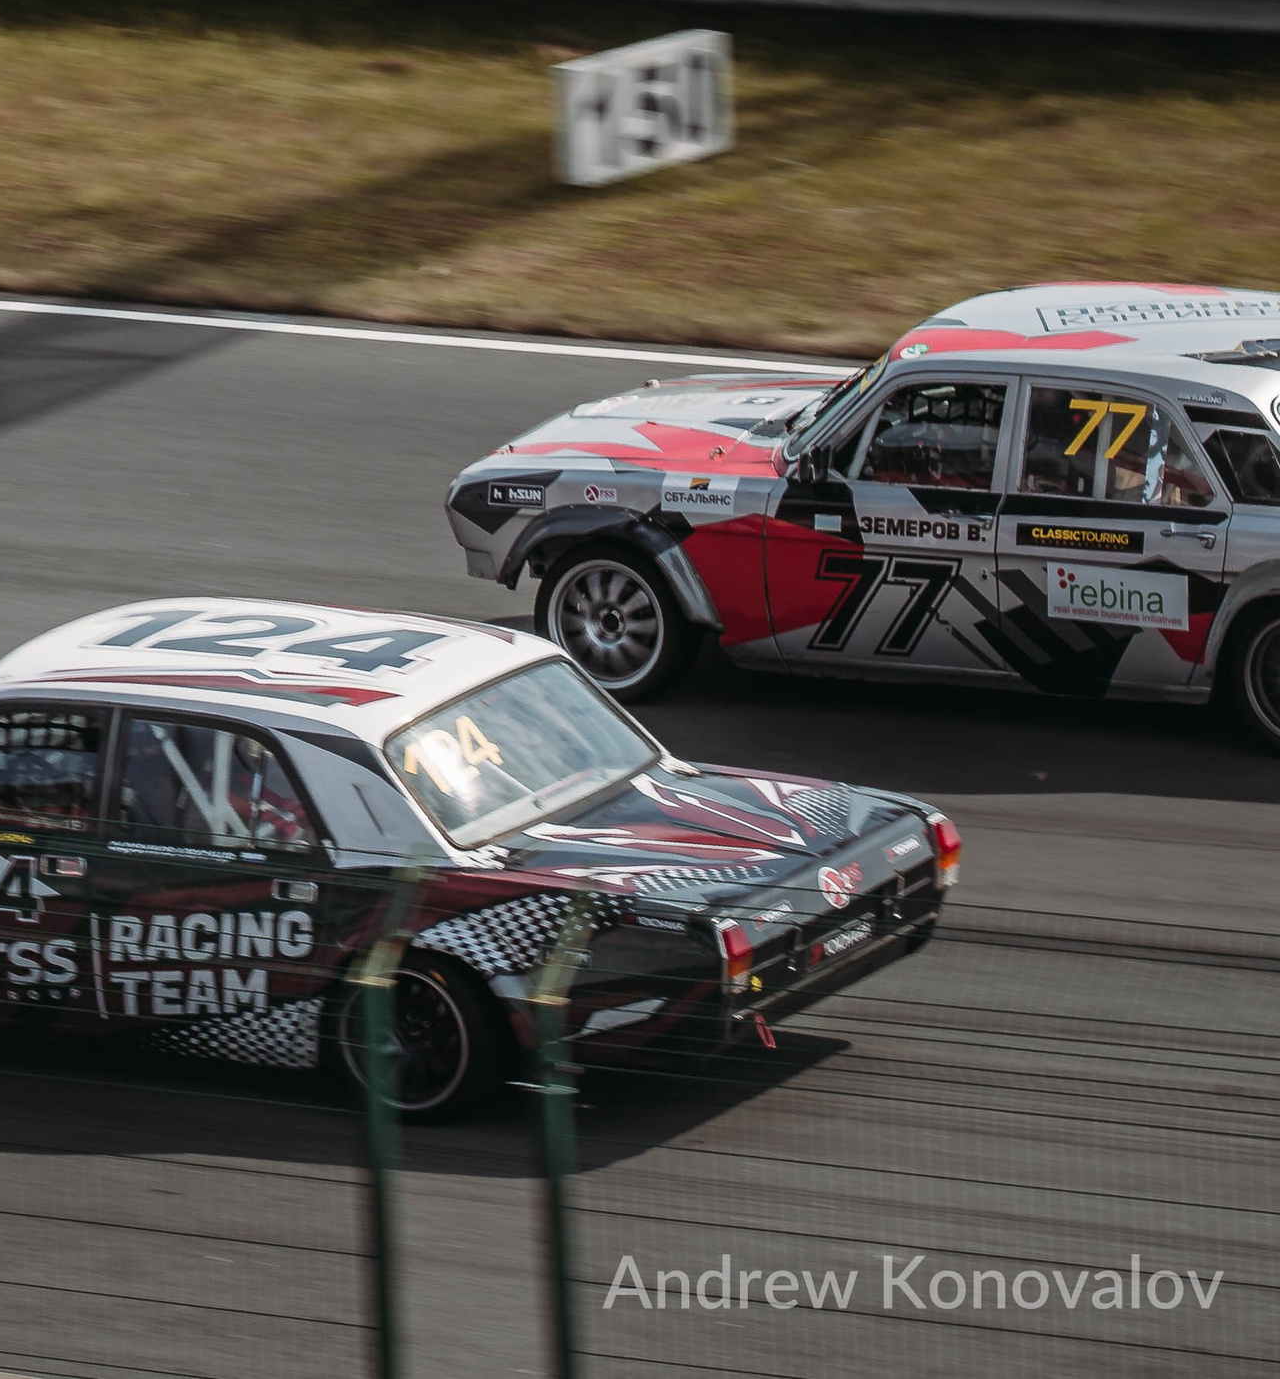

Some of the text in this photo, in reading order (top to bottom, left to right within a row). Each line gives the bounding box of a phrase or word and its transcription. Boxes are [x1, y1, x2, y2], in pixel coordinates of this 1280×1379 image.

[1064, 398, 1147, 458] 77
[664, 490, 732, 507] СБТ-АЛЬЯНС
[860, 515, 987, 542] ЗЕМЕРОВ В.
[806, 549, 963, 656] 77
[1053, 605, 1183, 626] real estate business initiatives
[1070, 579, 1164, 614] rebina
[98, 610, 448, 672] 124
[109, 910, 315, 962] RACING
[109, 969, 268, 1016] TEAM
